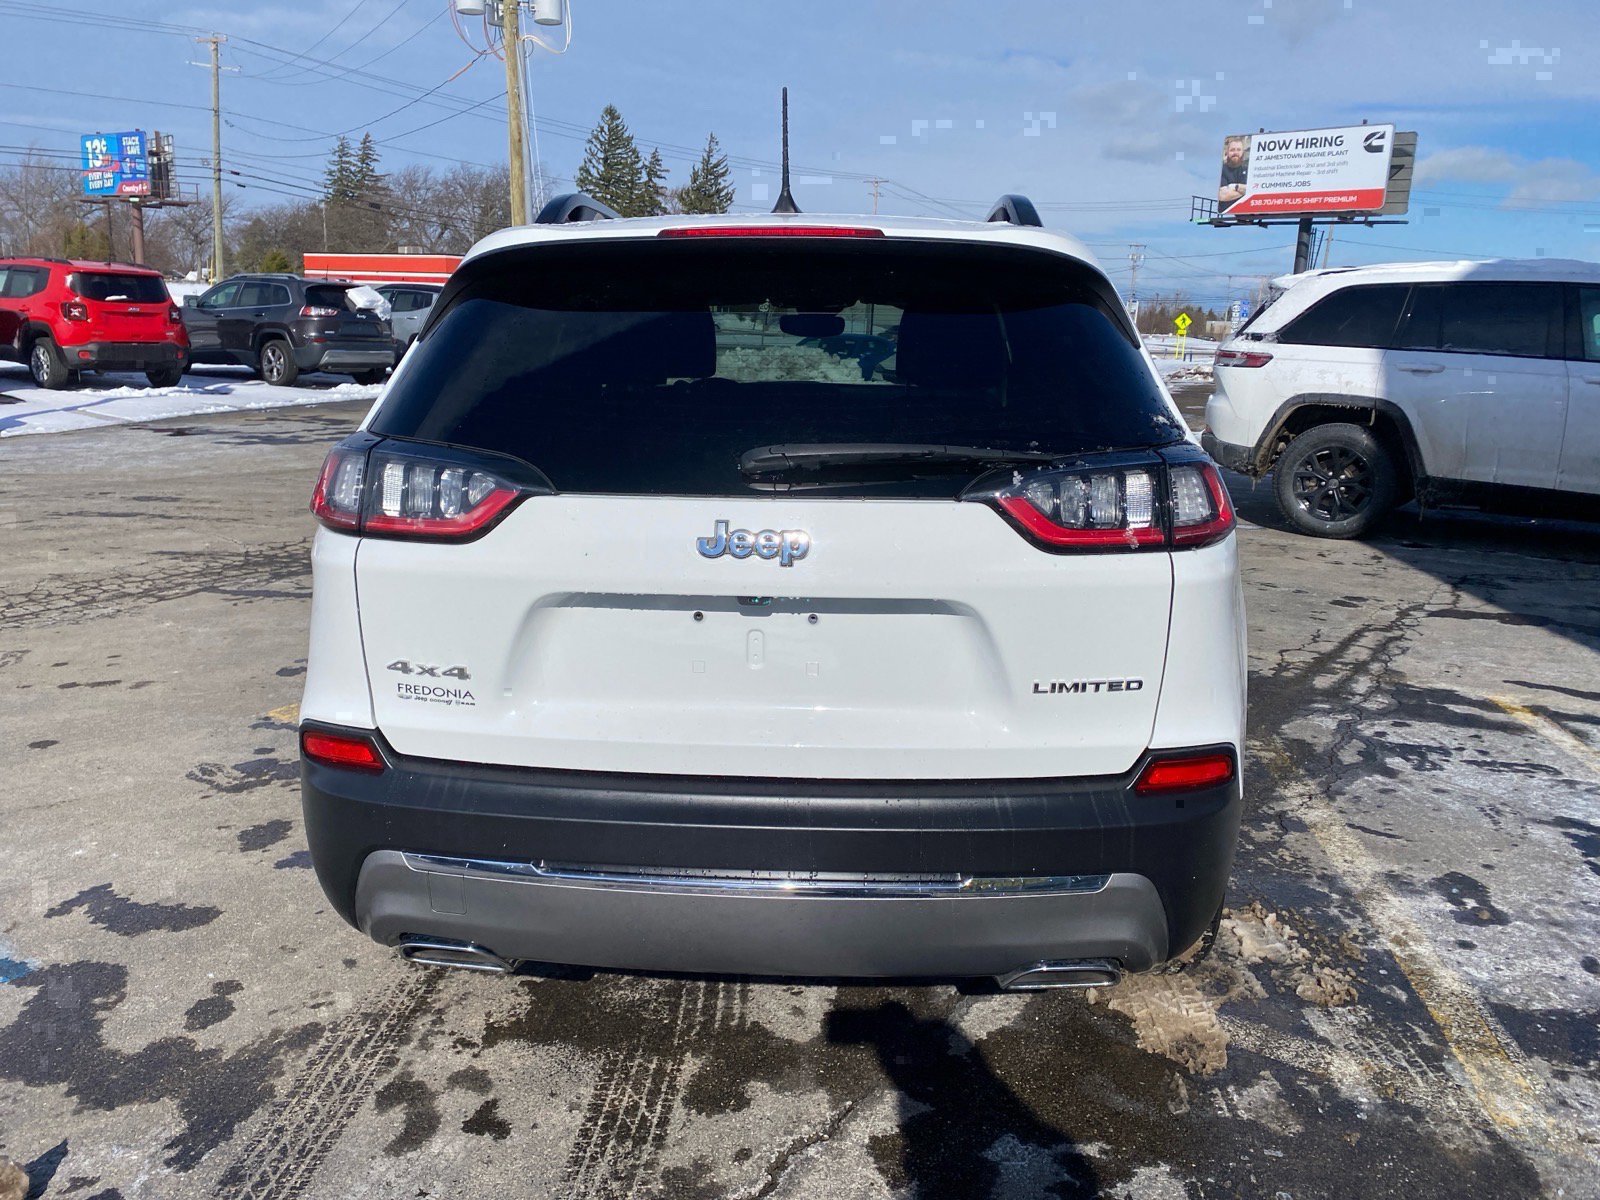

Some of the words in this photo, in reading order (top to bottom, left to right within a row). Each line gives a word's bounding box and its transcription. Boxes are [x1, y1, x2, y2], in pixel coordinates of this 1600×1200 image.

[1257, 139, 1292, 152] NOW
[1295, 135, 1344, 149] HIRING
[696, 519, 810, 567] Jeep
[397, 683, 475, 700] FREDONIA
[1033, 679, 1143, 693] LIMITED
